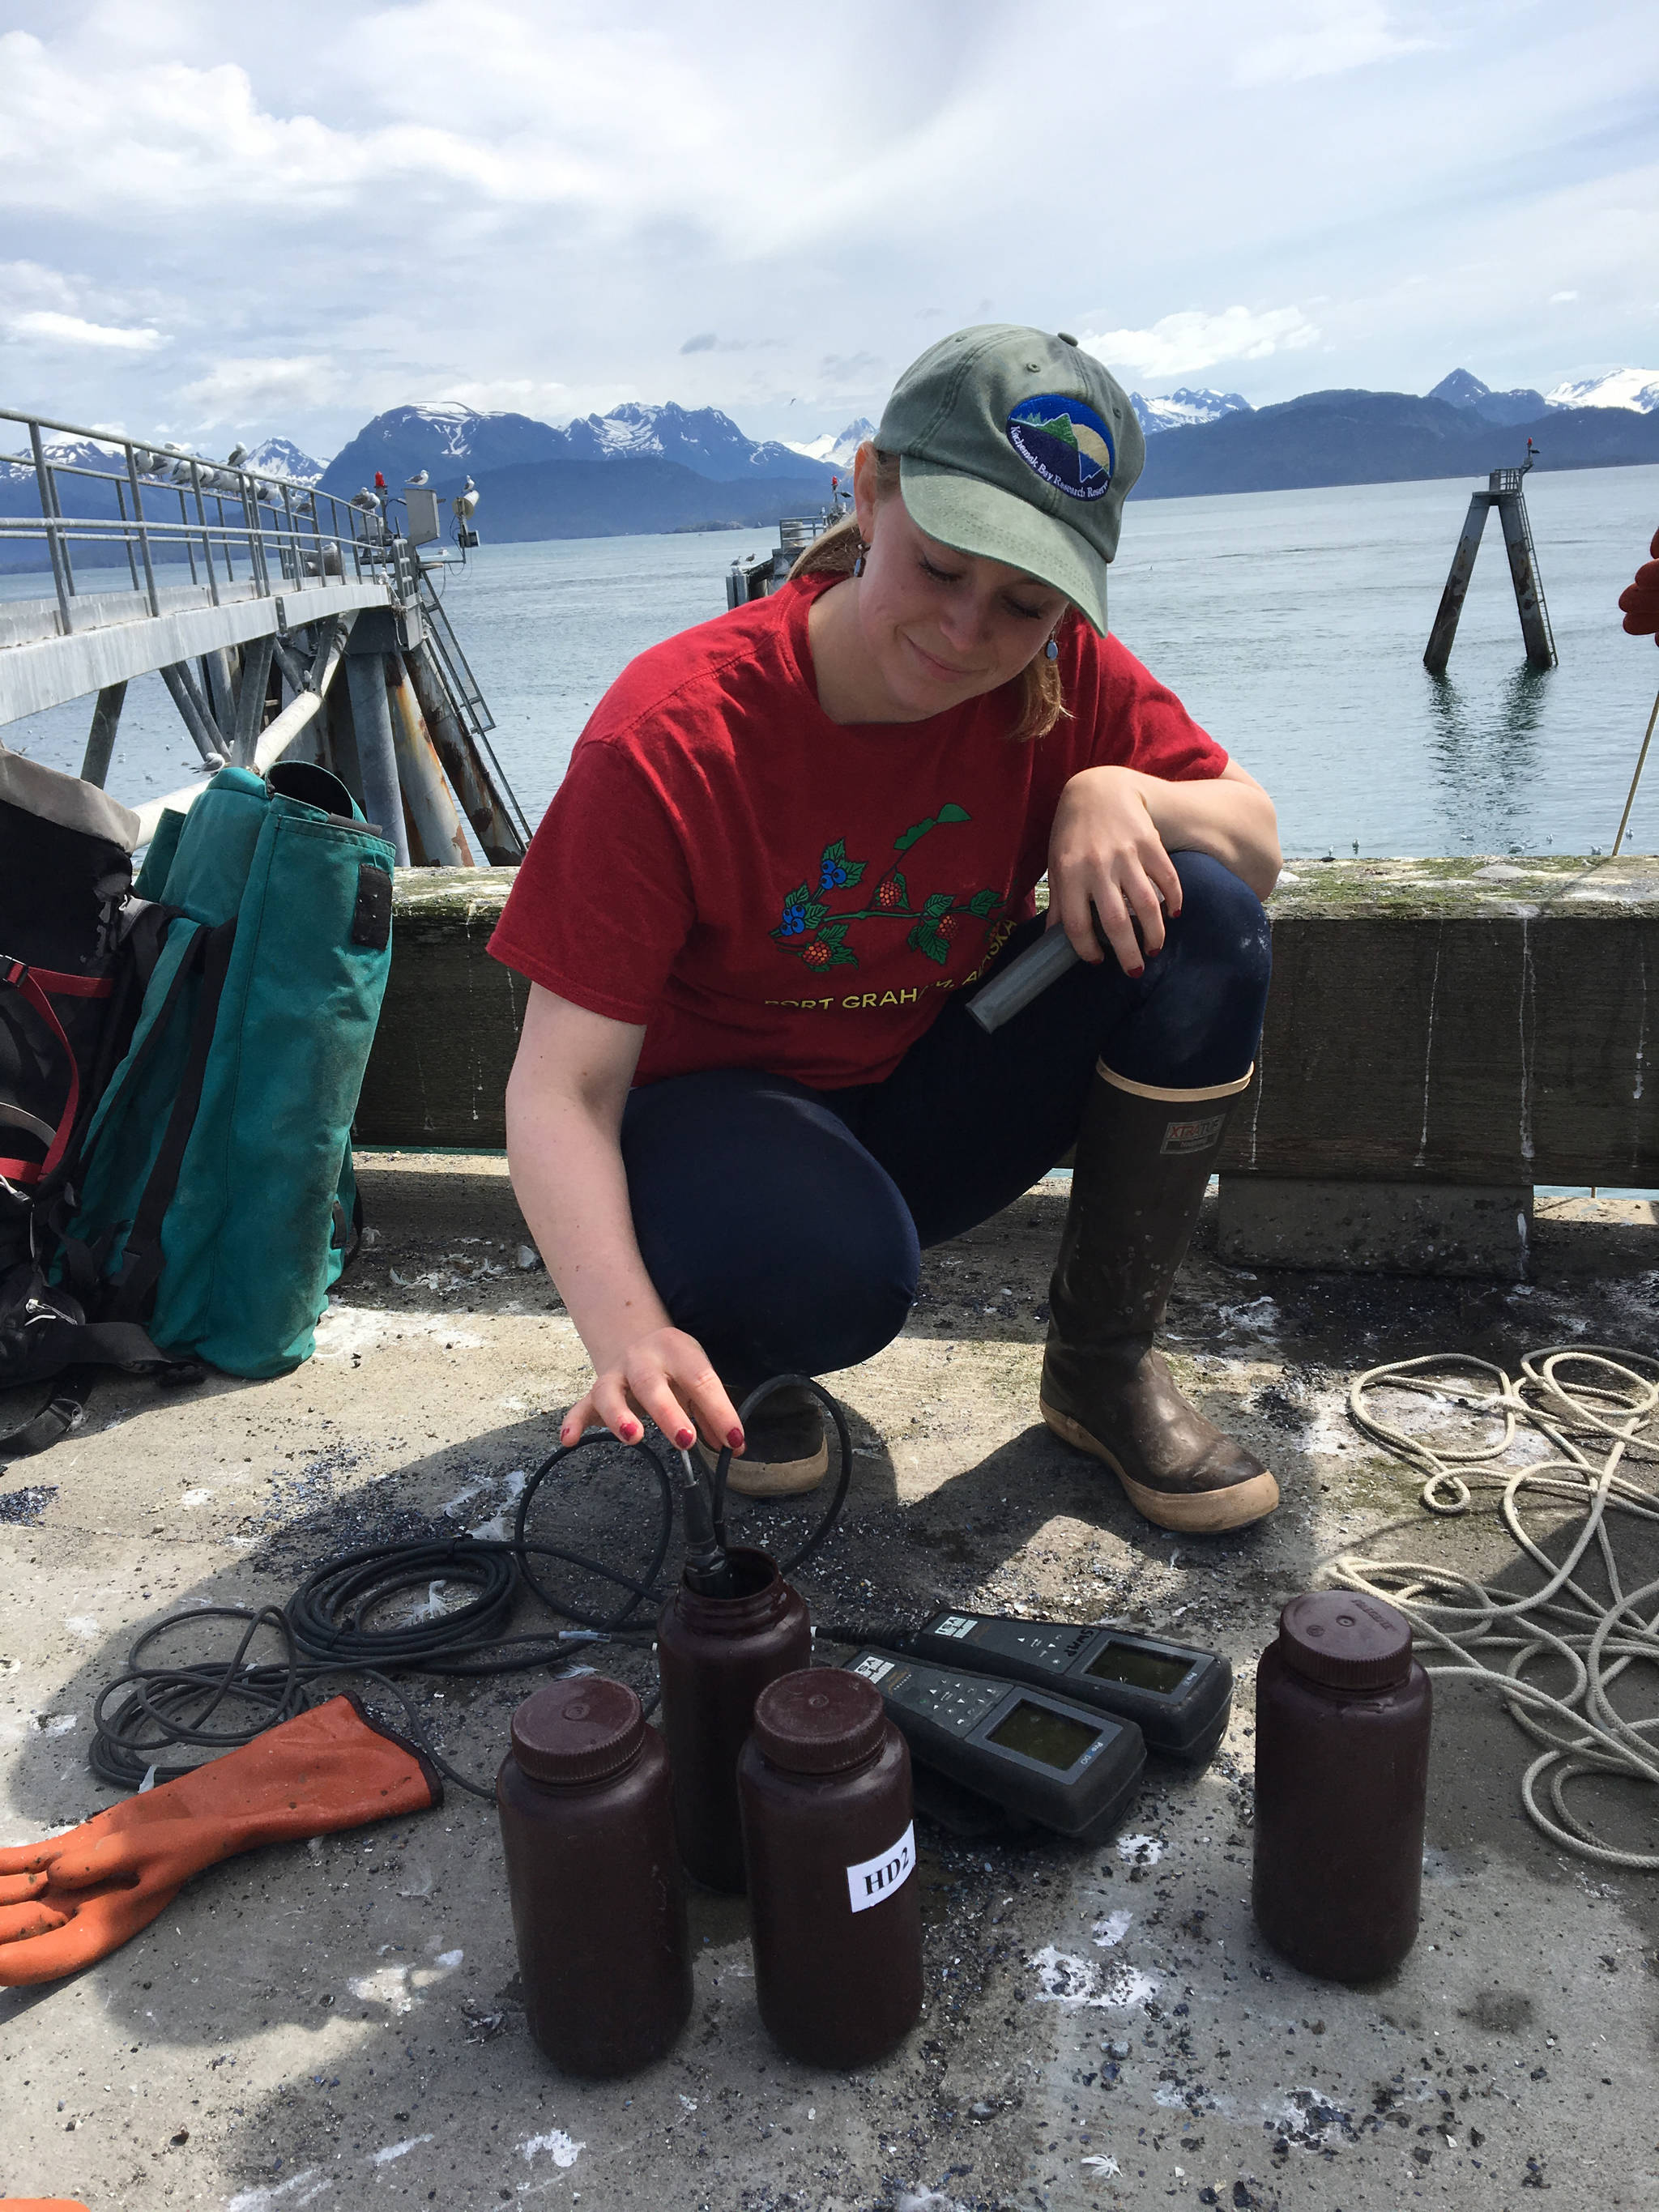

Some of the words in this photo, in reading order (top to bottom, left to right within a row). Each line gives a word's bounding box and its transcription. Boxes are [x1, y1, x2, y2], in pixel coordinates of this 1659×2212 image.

[1038, 463, 1054, 481] Bay
[1053, 475, 1086, 498] Research
[938, 1618, 958, 1633] YSI
[857, 1659, 876, 1673] YS
[864, 1846, 909, 1896] HD2
